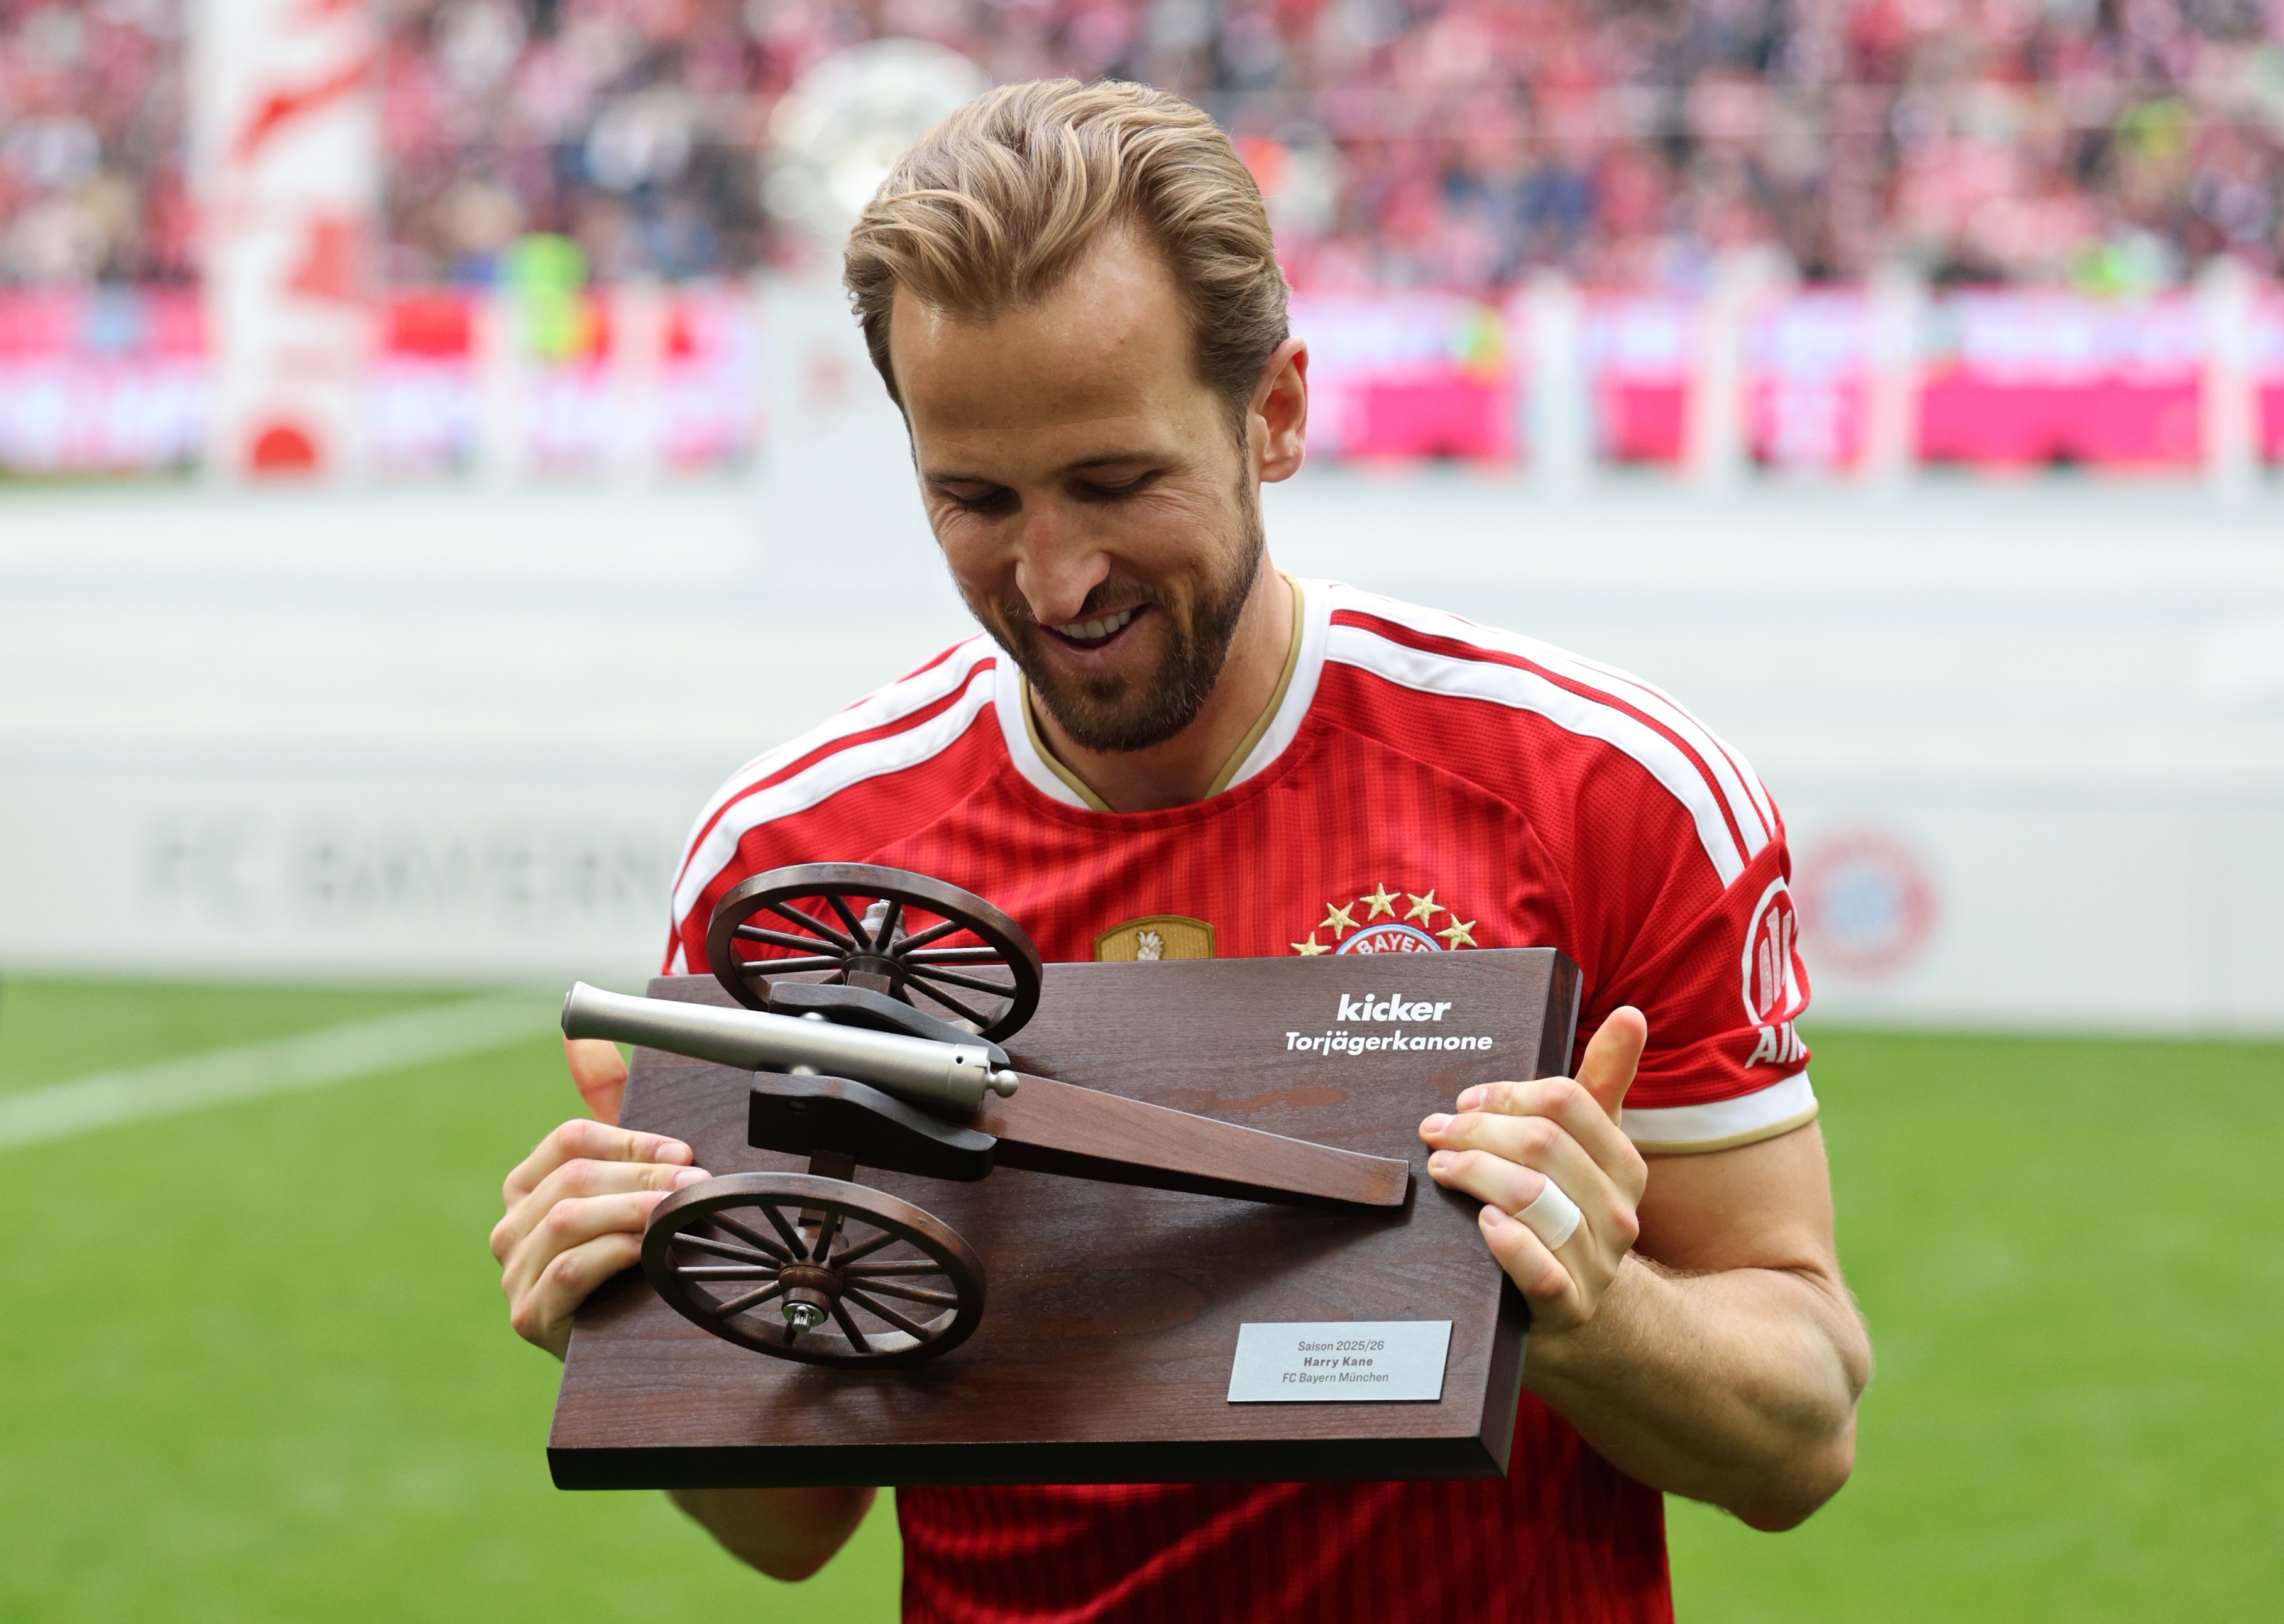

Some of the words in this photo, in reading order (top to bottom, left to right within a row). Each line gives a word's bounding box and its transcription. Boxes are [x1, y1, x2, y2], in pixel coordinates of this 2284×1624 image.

[1337, 994, 1451, 1021] kicker
[1286, 1030, 1493, 1056] Torjägerkanone
[1298, 1341, 1334, 1352] Saison
[1336, 1339, 1385, 1352] 2025/26
[1304, 1357, 1339, 1368] Harry
[1342, 1356, 1373, 1366] Kane
[1282, 1373, 1297, 1383] FC
[1299, 1373, 1336, 1385] Bayern
[1339, 1371, 1389, 1382] München
